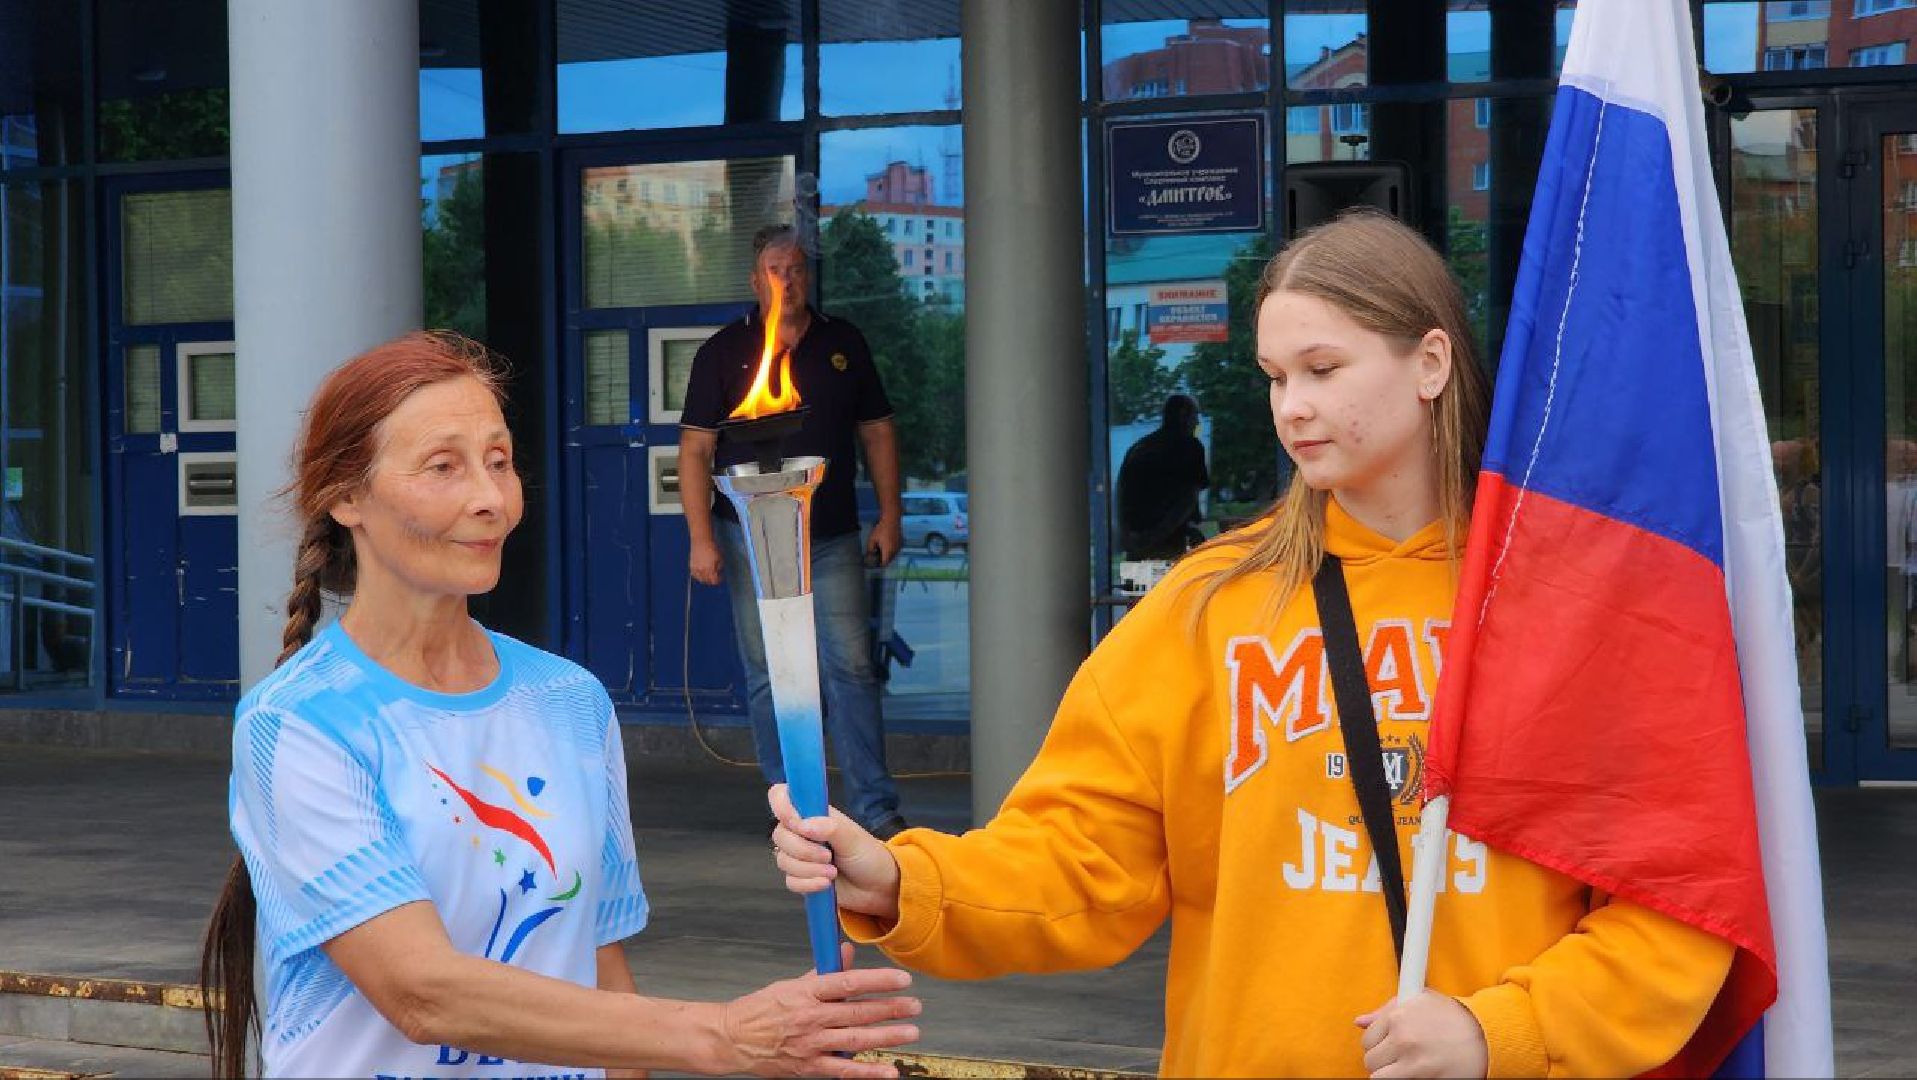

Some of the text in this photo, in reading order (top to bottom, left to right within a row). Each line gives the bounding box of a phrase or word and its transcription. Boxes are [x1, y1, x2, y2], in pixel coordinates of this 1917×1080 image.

[1157, 287, 1217, 299] ВНИМАНИЕ
[1396, 816, 1422, 826] JEAN
[1282, 807, 1488, 894] JES
